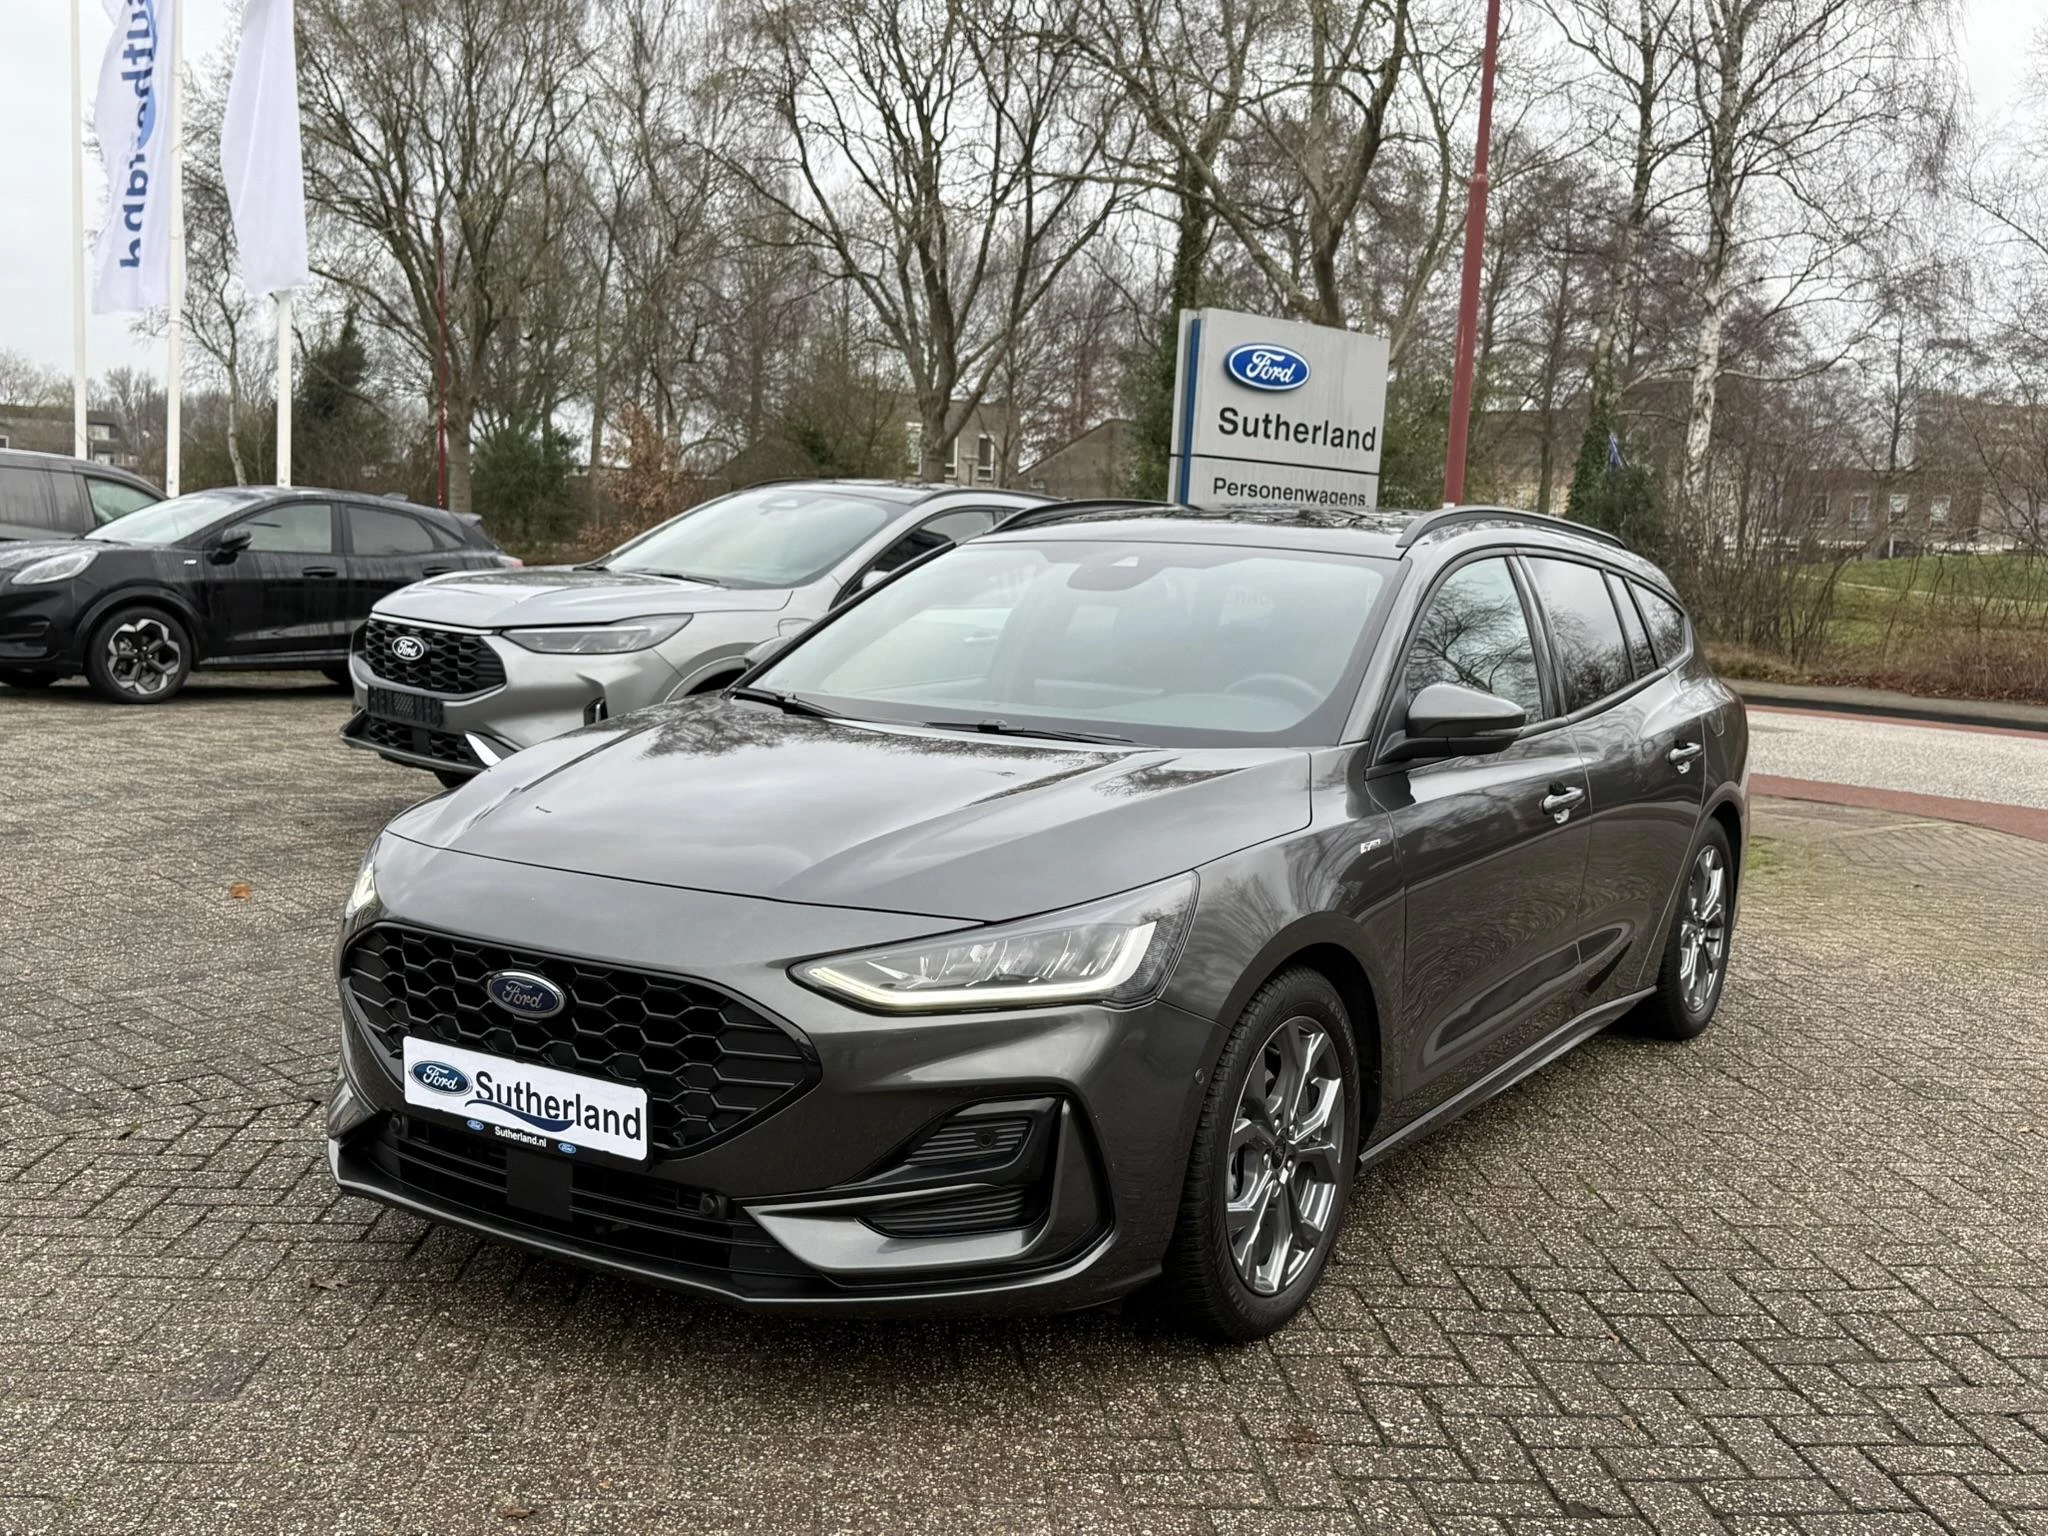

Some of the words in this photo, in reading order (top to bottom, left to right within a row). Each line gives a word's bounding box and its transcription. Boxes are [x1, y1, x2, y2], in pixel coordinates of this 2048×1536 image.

[1246, 350, 1296, 383] Ford
[1218, 407, 1376, 451] Sutherland
[1213, 477, 1366, 506] Personenwagens
[397, 640, 417, 657] Ford
[502, 980, 543, 1009] Ford
[422, 1064, 458, 1091] Ford
[475, 1071, 642, 1140] Sutherland
[494, 1125, 547, 1148] Sutherland.nl
